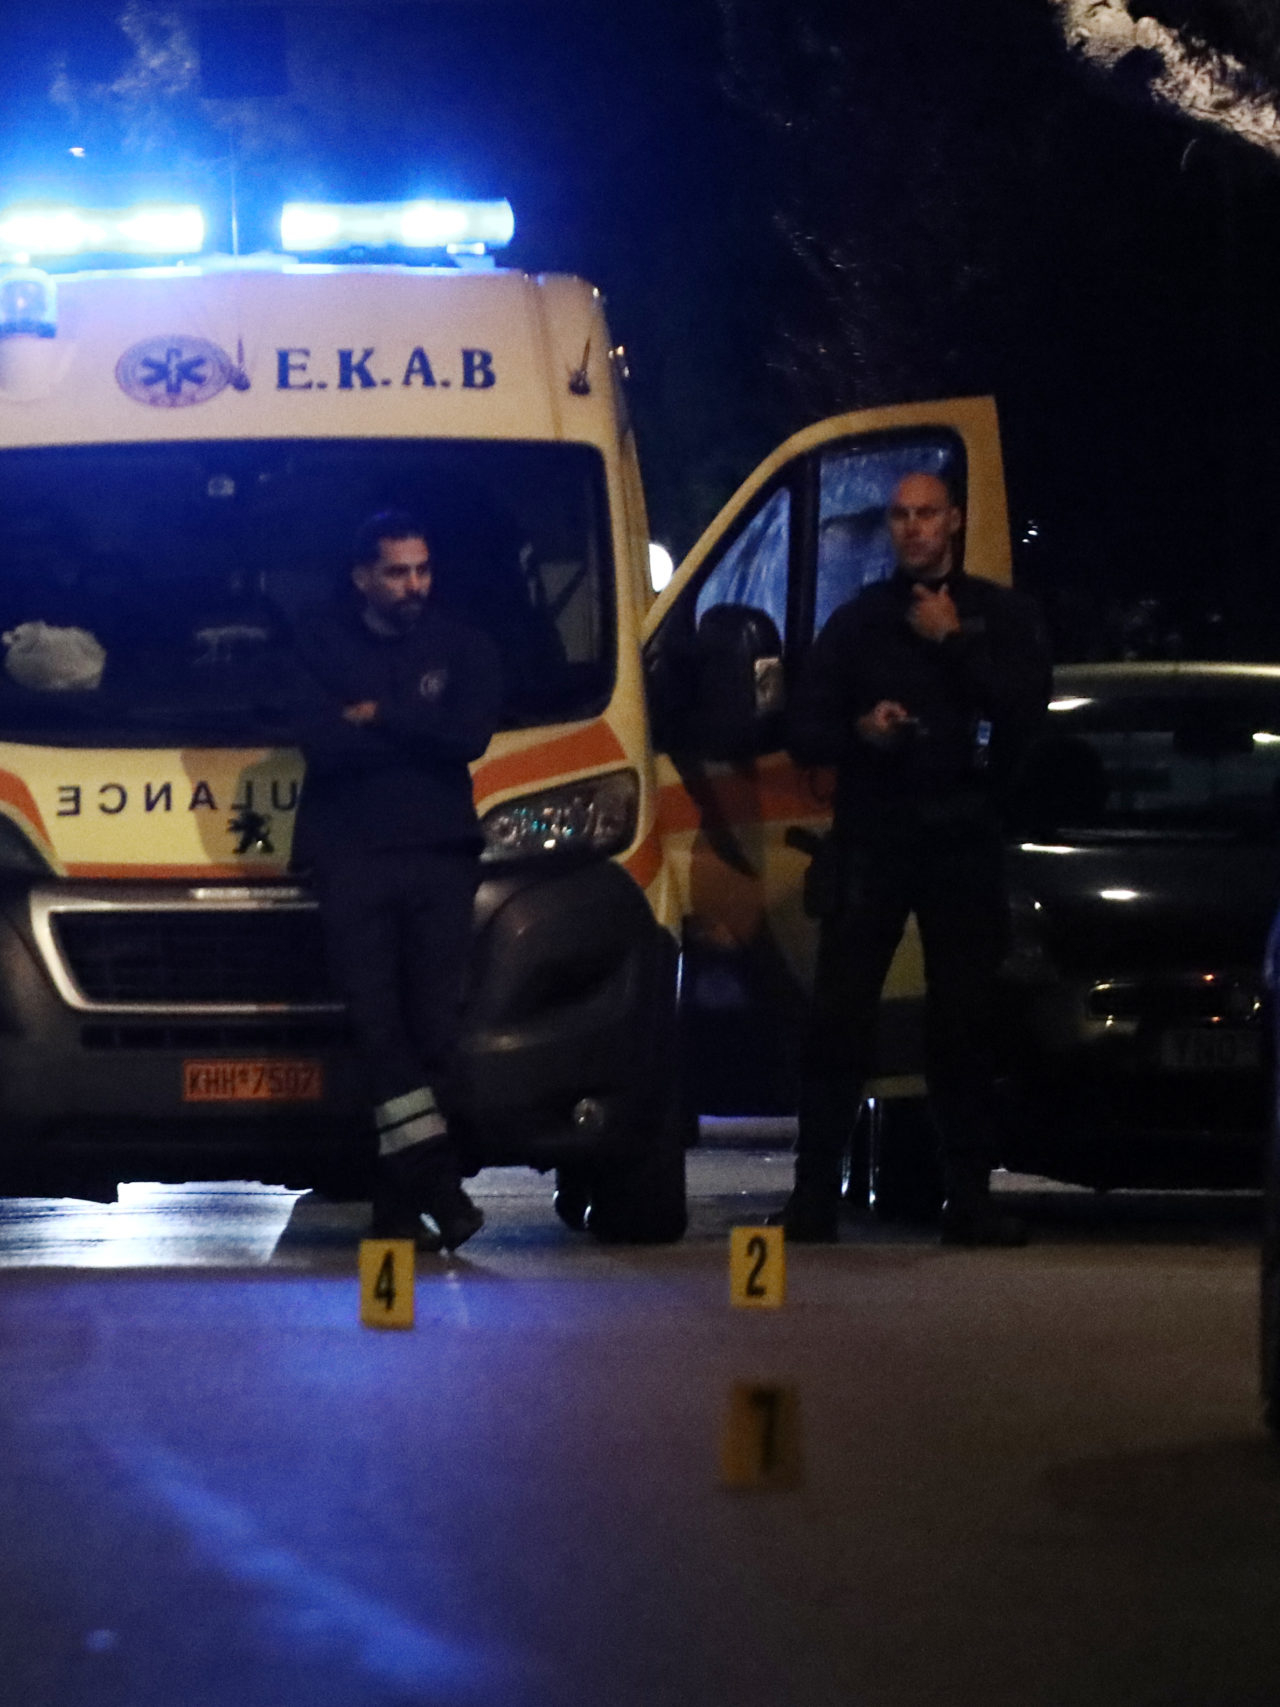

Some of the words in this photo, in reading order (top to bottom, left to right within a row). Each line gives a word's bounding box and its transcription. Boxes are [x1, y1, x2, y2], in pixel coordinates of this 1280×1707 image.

[276, 346, 497, 390] E.K.A.B
[373, 1248, 397, 1312] 4
[745, 1236, 768, 1297] 2
